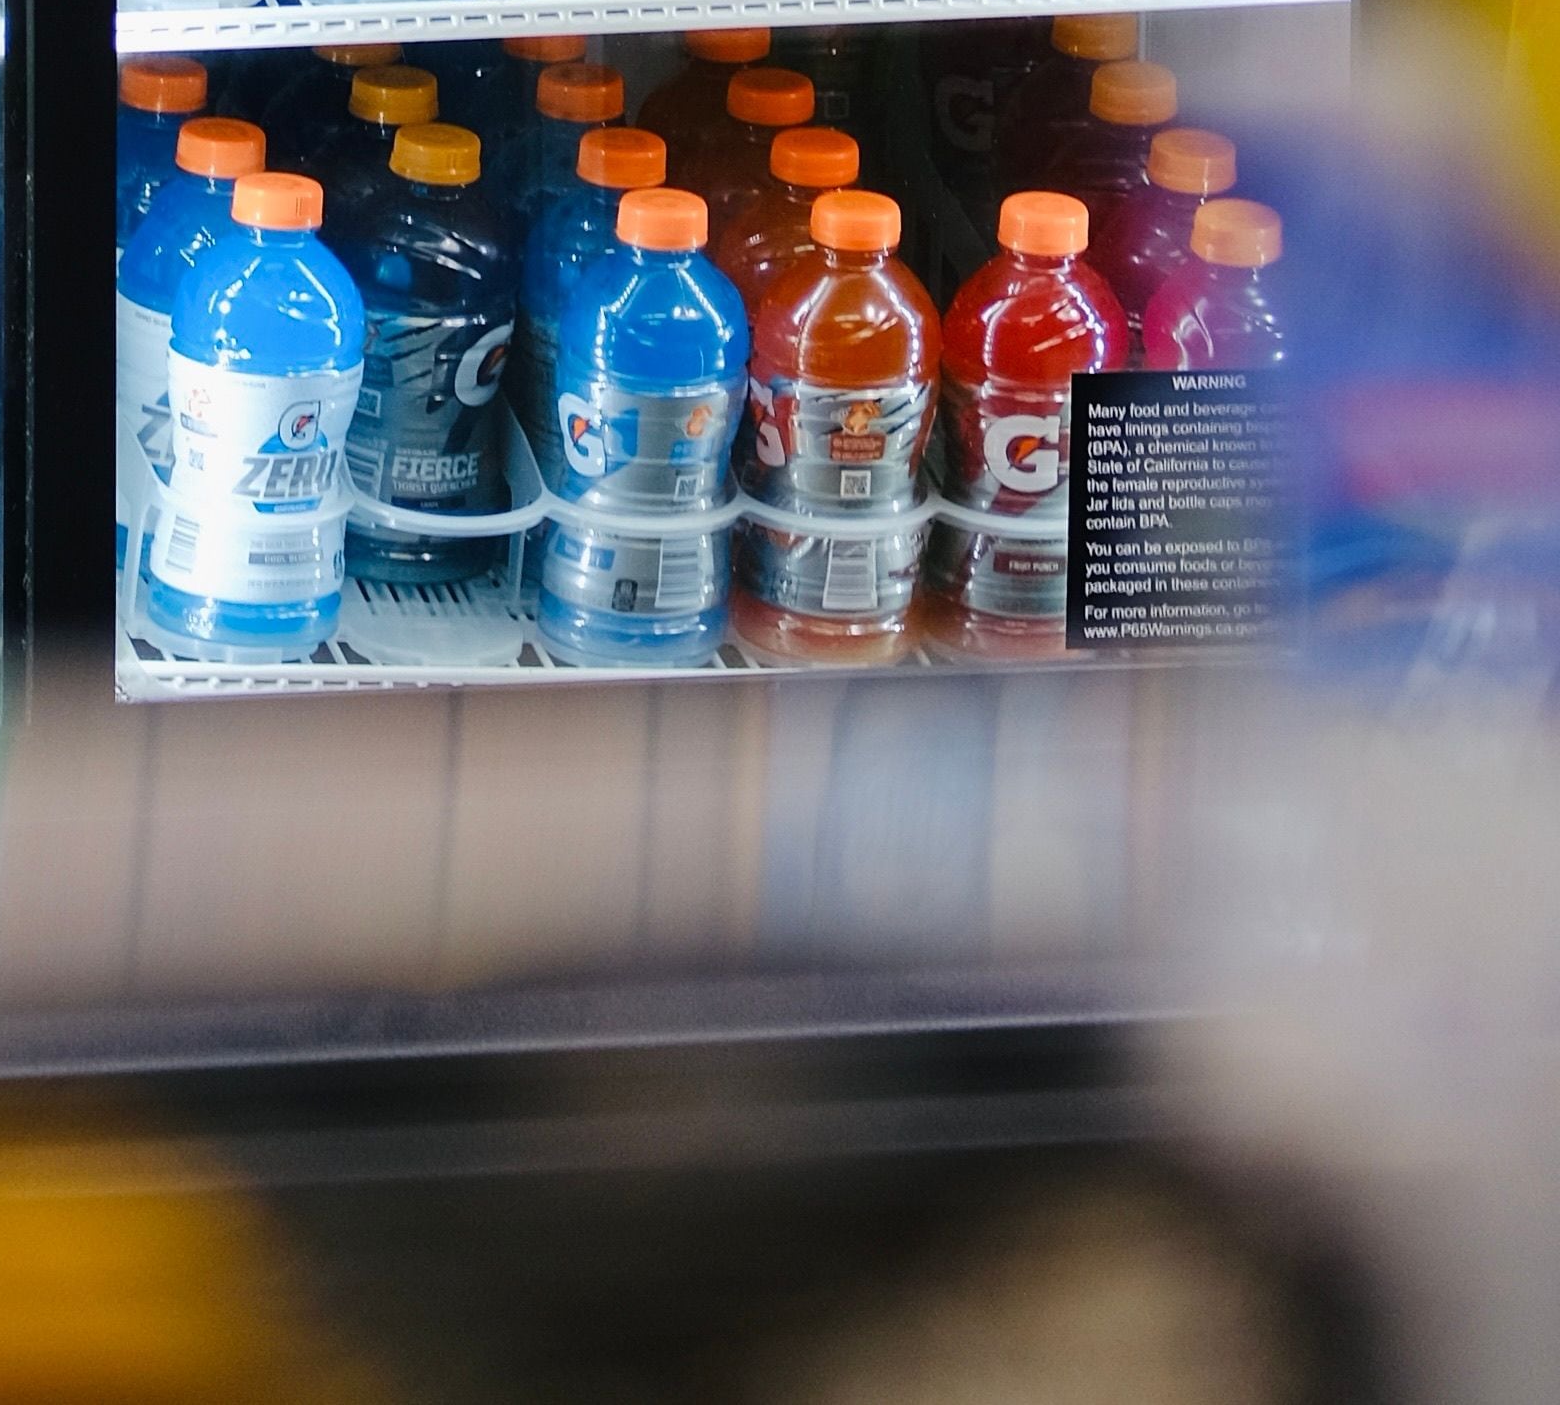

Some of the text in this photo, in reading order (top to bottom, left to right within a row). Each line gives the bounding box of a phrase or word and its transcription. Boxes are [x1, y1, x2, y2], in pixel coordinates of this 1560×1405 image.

[1172, 376, 1246, 390] WARNING
[1088, 404, 1126, 420] Many
[1130, 404, 1160, 418] food
[1164, 402, 1190, 416] and
[1192, 402, 1256, 418] beverage
[278, 400, 321, 451] G
[1088, 423, 1122, 438] have
[1126, 422, 1169, 438] linings
[1172, 421, 1242, 437] containing
[983, 415, 1062, 492] G
[1088, 440, 1256, 458] (BPA), a chemical known
[391, 451, 481, 482] FIERCE
[1087, 460, 1123, 474] State
[1126, 460, 1141, 473] of
[1144, 457, 1208, 473] California
[1212, 458, 1225, 471] to
[231, 452, 339, 499] ZERO
[393, 477, 479, 495] THIRST QUENCHER
[1087, 478, 1108, 493] the
[1112, 478, 1158, 492] female
[1162, 477, 1246, 493] reproductive
[1086, 495, 1242, 512] Jar lids and bottle caps
[1086, 514, 1172, 530] contain BPA.
[1086, 540, 1240, 557] You can be exposed to
[1085, 561, 1111, 577] you
[1114, 560, 1176, 574] consume
[1180, 559, 1217, 572] foods
[1220, 559, 1234, 571] or
[1085, 577, 1209, 596] packaged in these
[1084, 606, 1108, 620] For
[1112, 606, 1146, 619] more
[1150, 603, 1230, 618] information,
